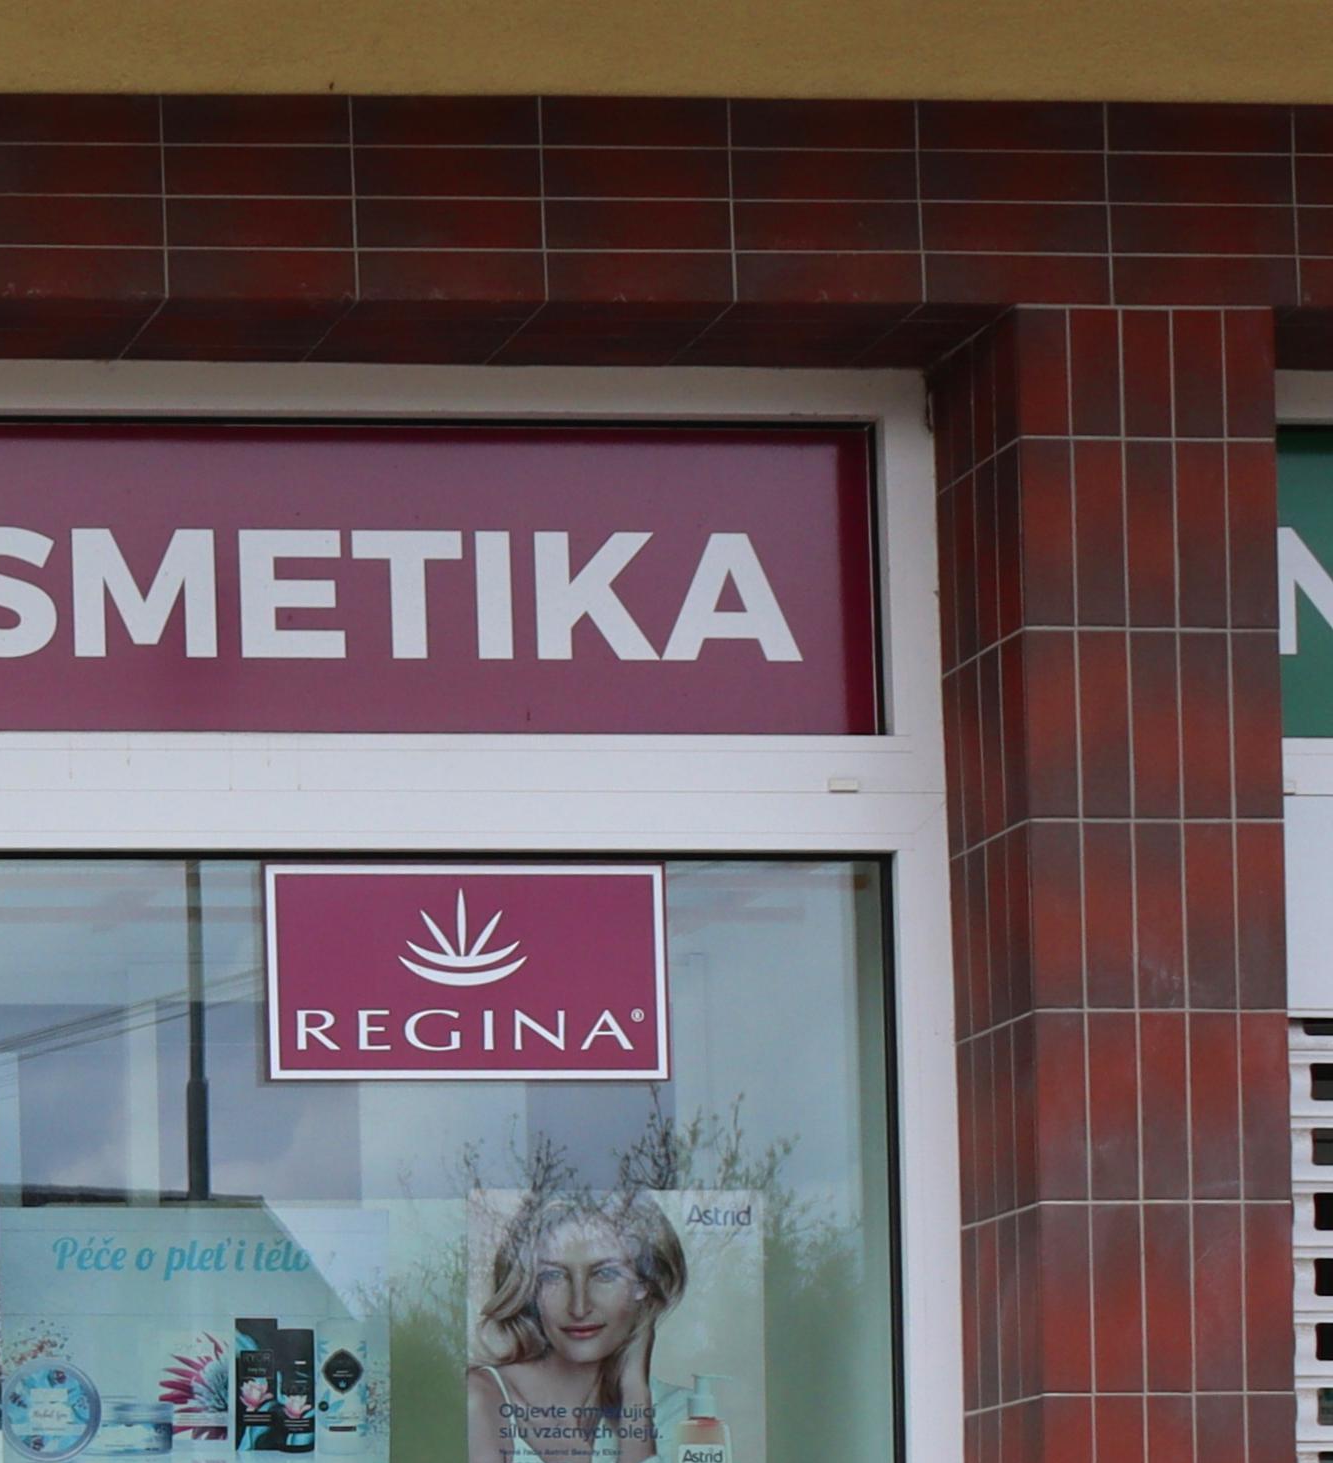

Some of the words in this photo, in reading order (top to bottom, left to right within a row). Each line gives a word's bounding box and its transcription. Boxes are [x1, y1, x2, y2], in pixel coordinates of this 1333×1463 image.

[293, 1007, 635, 1052] REGINA
[685, 1204, 752, 1227] Astrid
[52, 1235, 126, 1272] Péče
[135, 1249, 156, 1272] o
[163, 1238, 231, 1281] pleť
[253, 1236, 311, 1272] tělo
[499, 1403, 567, 1423] Objevte
[498, 1424, 528, 1439] sílu
[533, 1424, 613, 1442] vzácných
[682, 1447, 723, 1463] Astrid
